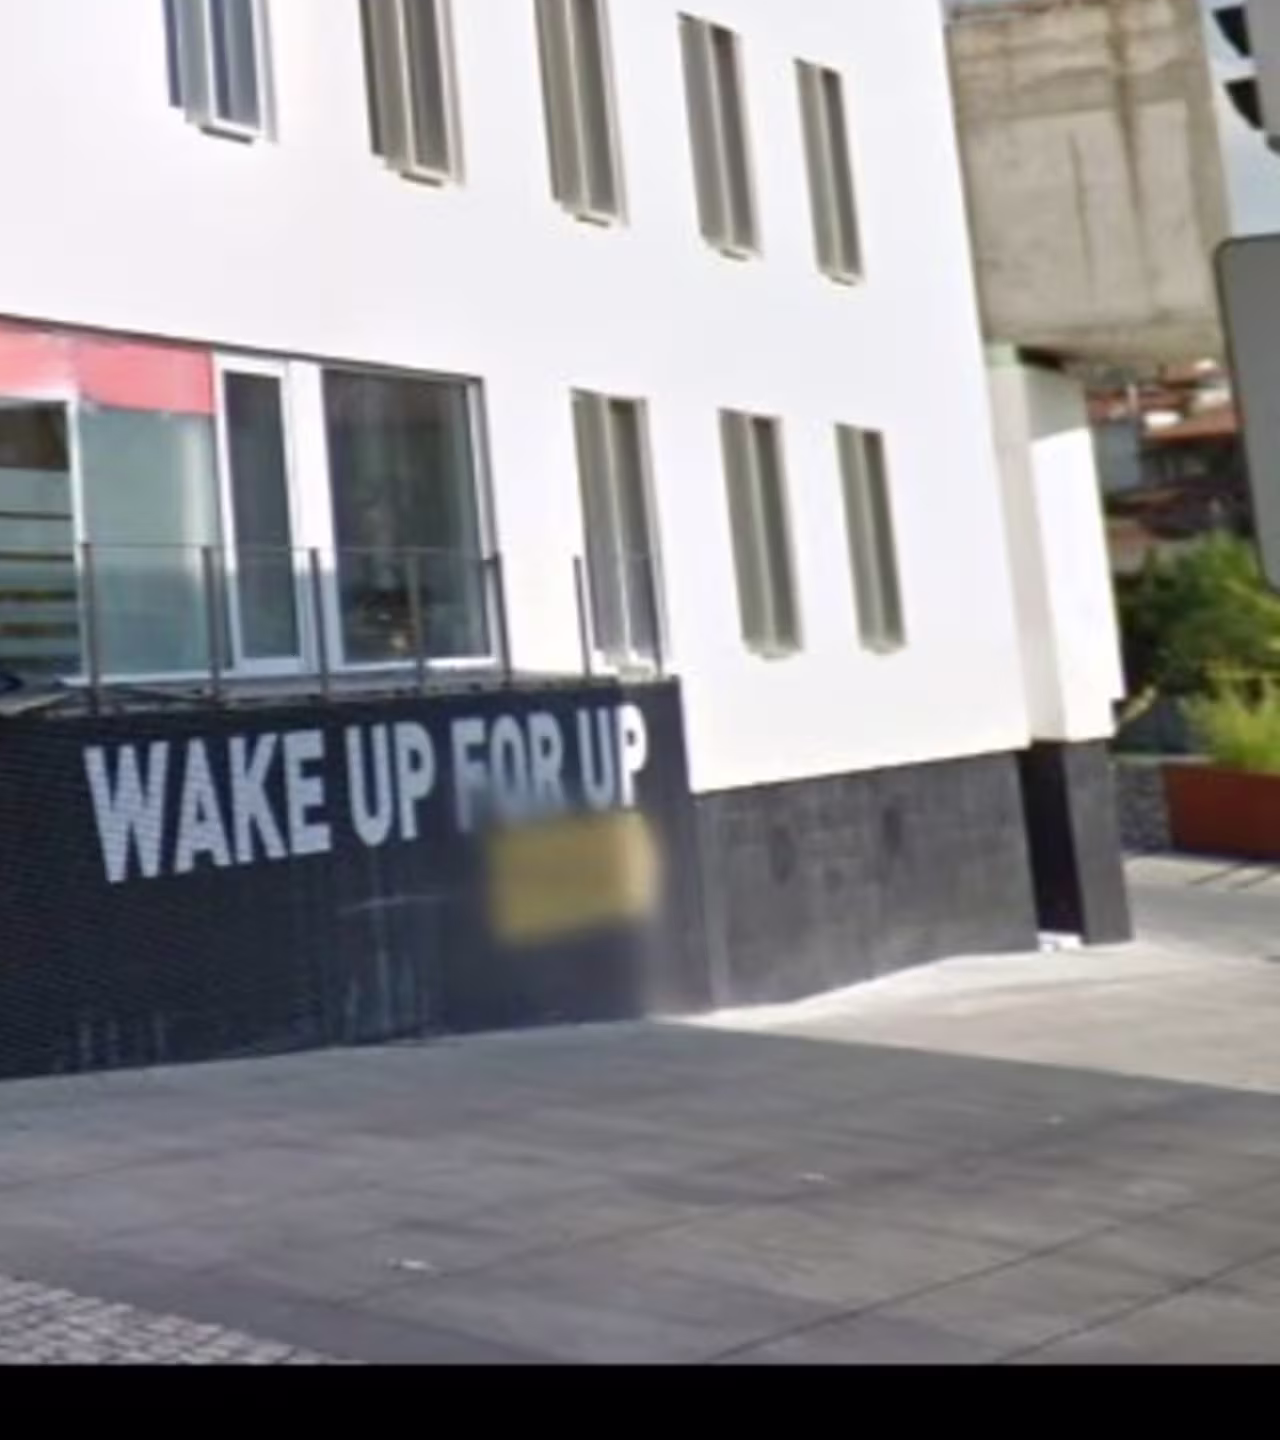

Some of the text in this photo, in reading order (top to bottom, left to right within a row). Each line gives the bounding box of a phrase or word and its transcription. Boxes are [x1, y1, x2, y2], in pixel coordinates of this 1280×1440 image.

[83, 703, 649, 884] WAKE UP FOR UP
